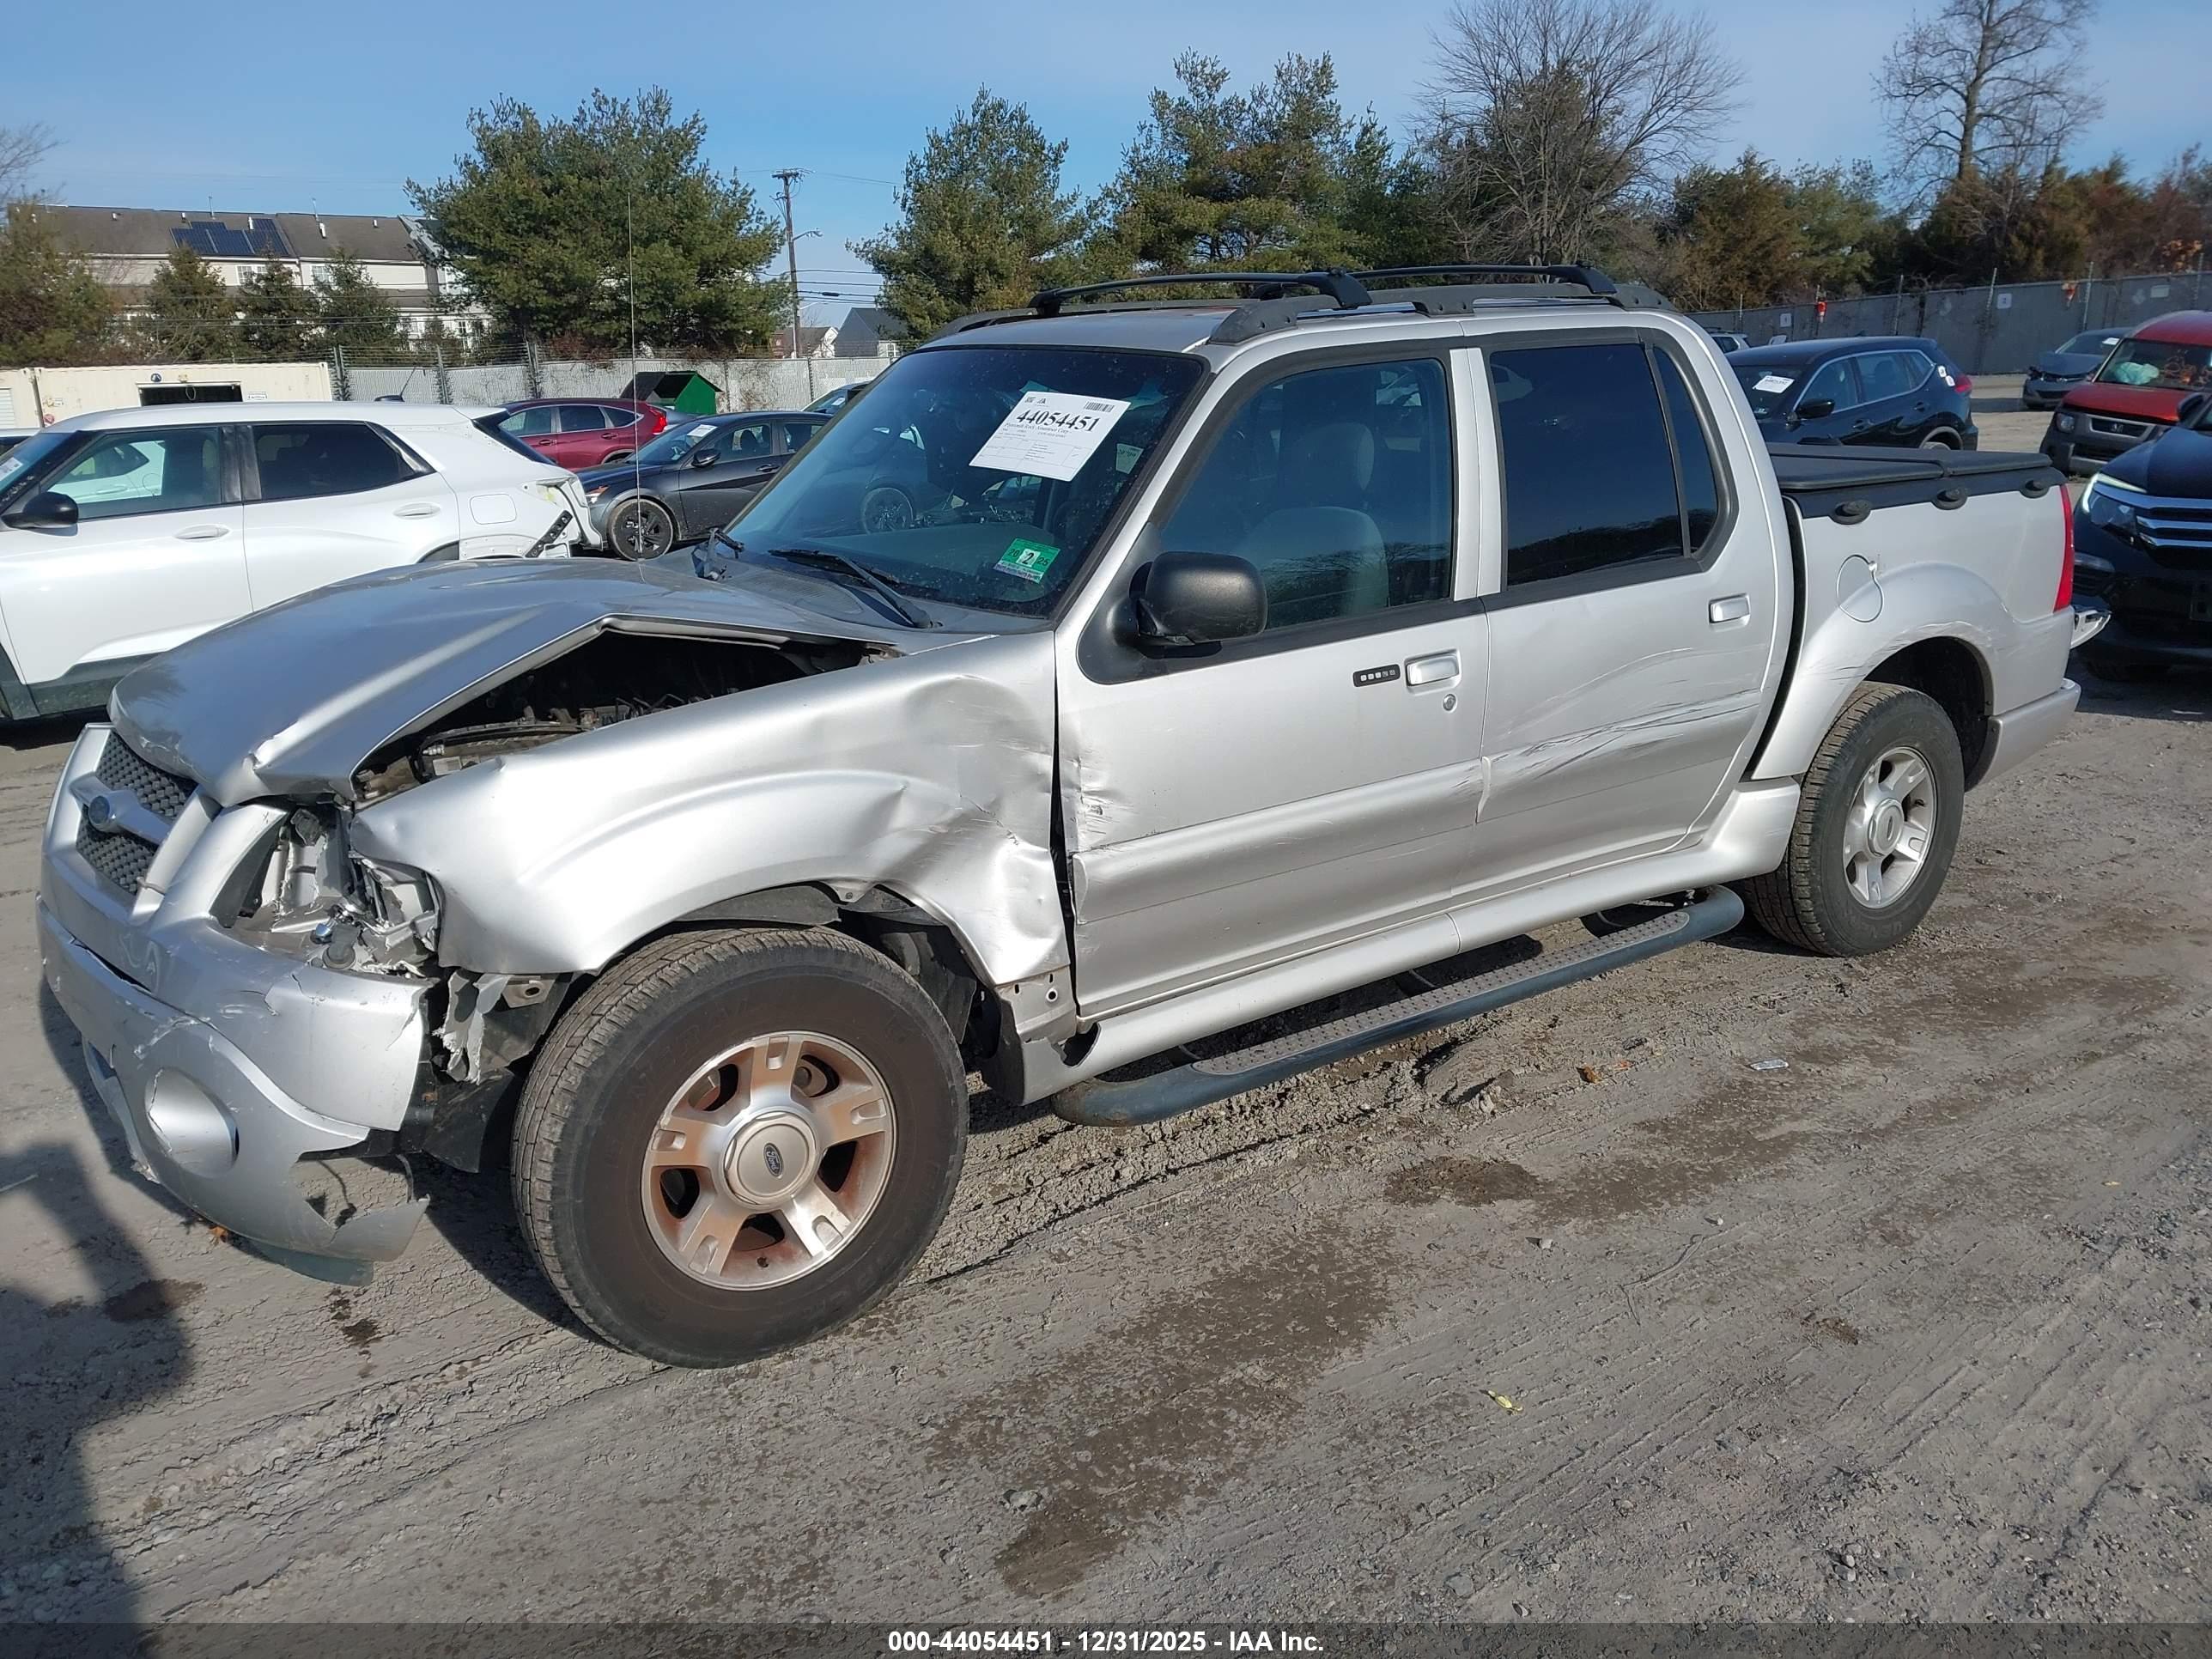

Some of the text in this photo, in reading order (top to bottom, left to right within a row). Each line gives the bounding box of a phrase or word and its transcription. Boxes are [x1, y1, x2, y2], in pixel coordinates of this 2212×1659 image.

[1017, 409, 1100, 432] 44054451
[1008, 549, 1020, 558] 20
[1022, 552, 1034, 564] 2
[766, 1150, 781, 1172] Ford
